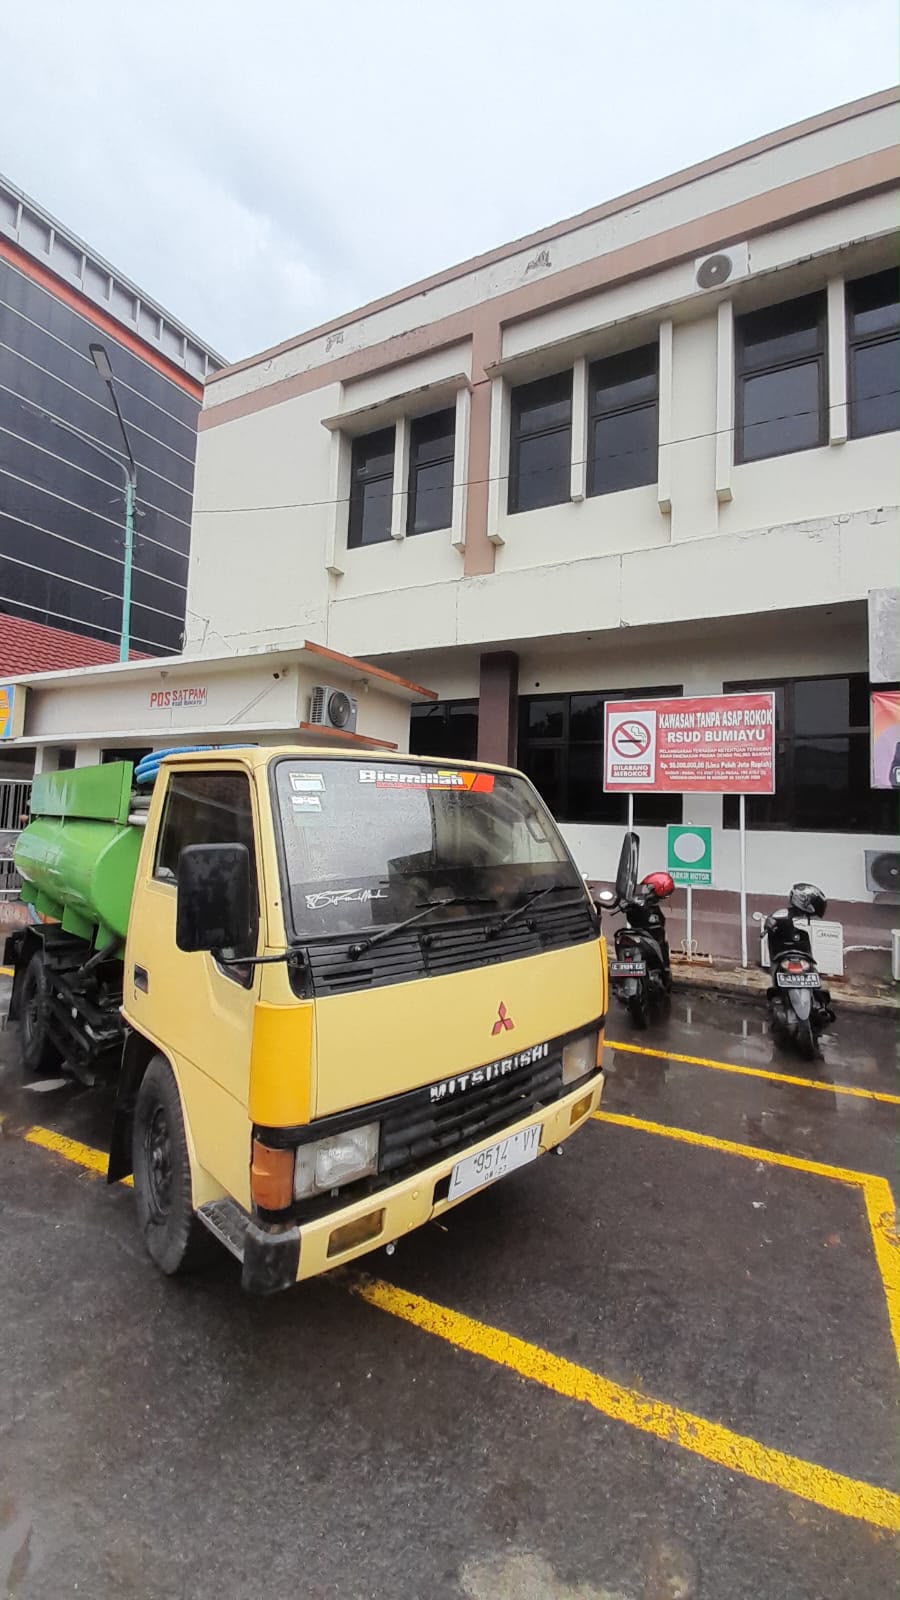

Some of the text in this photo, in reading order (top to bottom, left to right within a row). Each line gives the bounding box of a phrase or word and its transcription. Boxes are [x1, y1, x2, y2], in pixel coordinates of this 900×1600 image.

[150, 688, 206, 707] POS SATPAM
[659, 709, 773, 729] KAWASAN TANPA ASAP ROKOK
[667, 729, 765, 743] RSUD BUMIAYU
[359, 769, 464, 785] Bismillah
[690, 872, 711, 882] MOTOR
[429, 1042, 549, 1103] MITSUBISHI
[475, 1140, 510, 1174] 9514
[523, 1127, 538, 1152] VY
